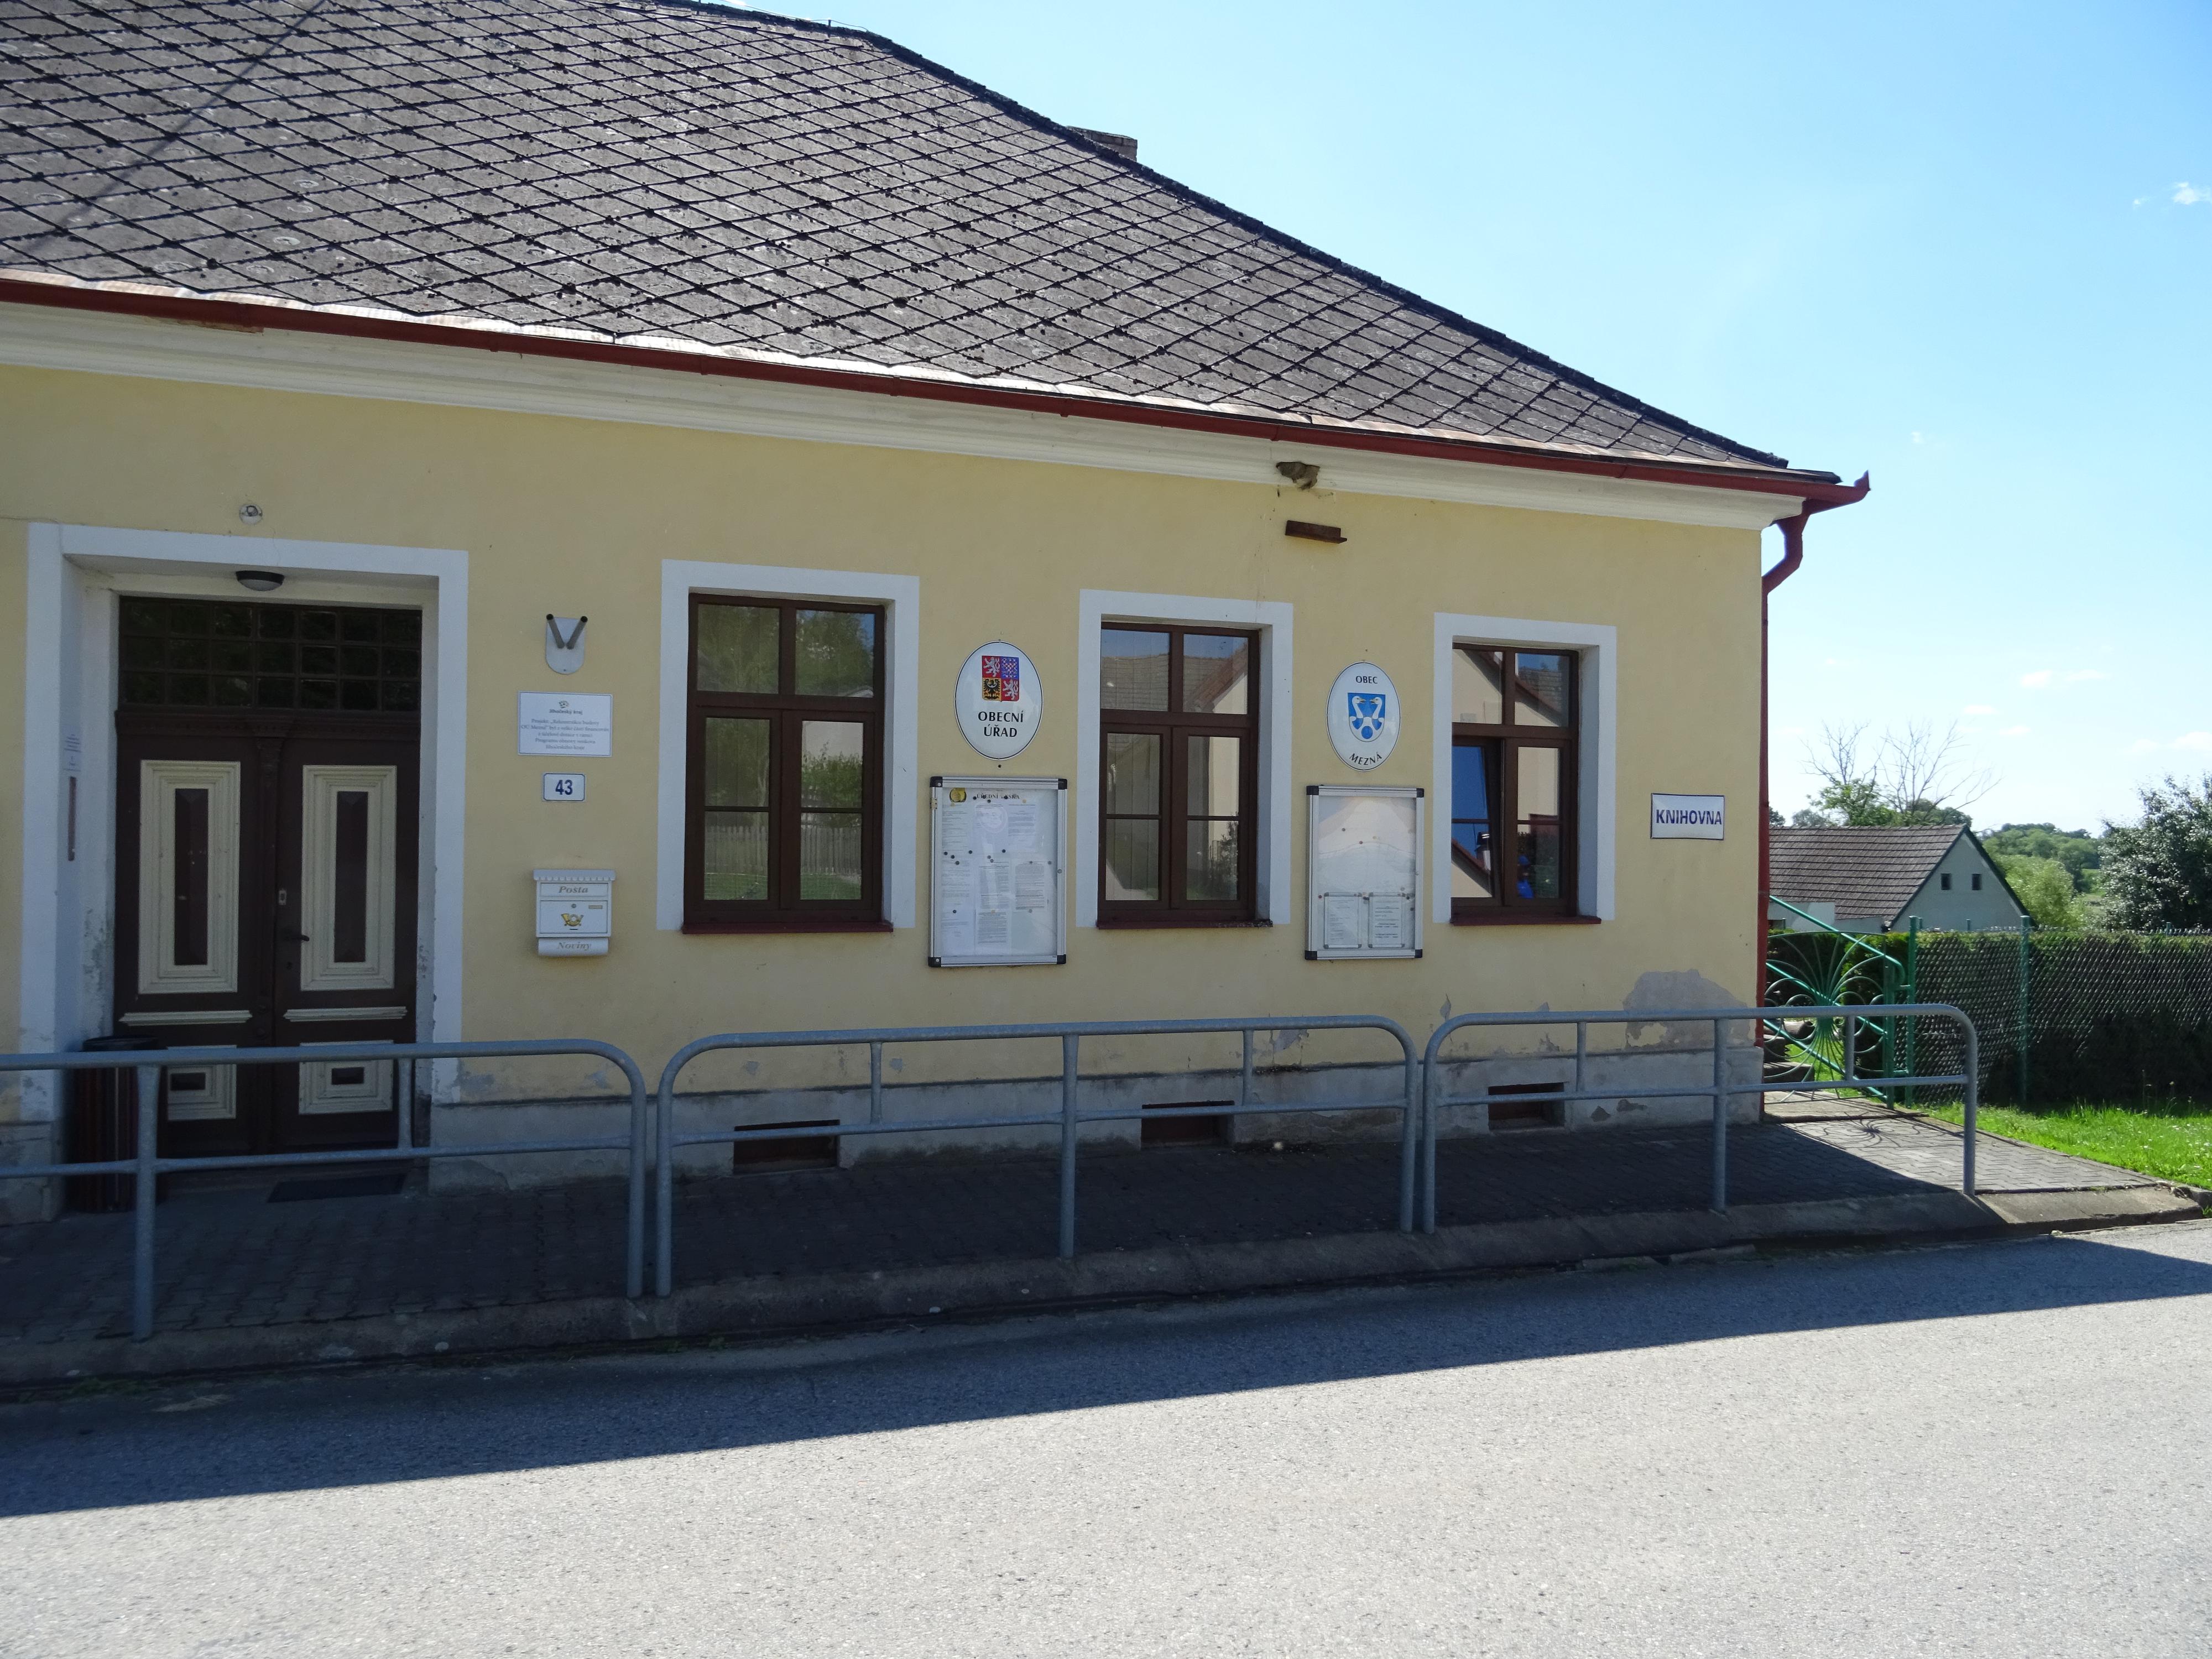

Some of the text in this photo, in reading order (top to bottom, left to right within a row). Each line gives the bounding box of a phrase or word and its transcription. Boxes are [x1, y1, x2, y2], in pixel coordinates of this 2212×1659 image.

[1355, 676, 1378, 684] OBEC
[978, 711, 1024, 723] OBECNÍ
[984, 724, 1018, 737] ÚŘAD
[1349, 752, 1383, 765] MEZNÁ
[555, 779, 573, 795] 43
[1656, 809, 1722, 825] KNIHOVNA
[558, 885, 588, 894] Pošta
[557, 941, 592, 951] Noviny
